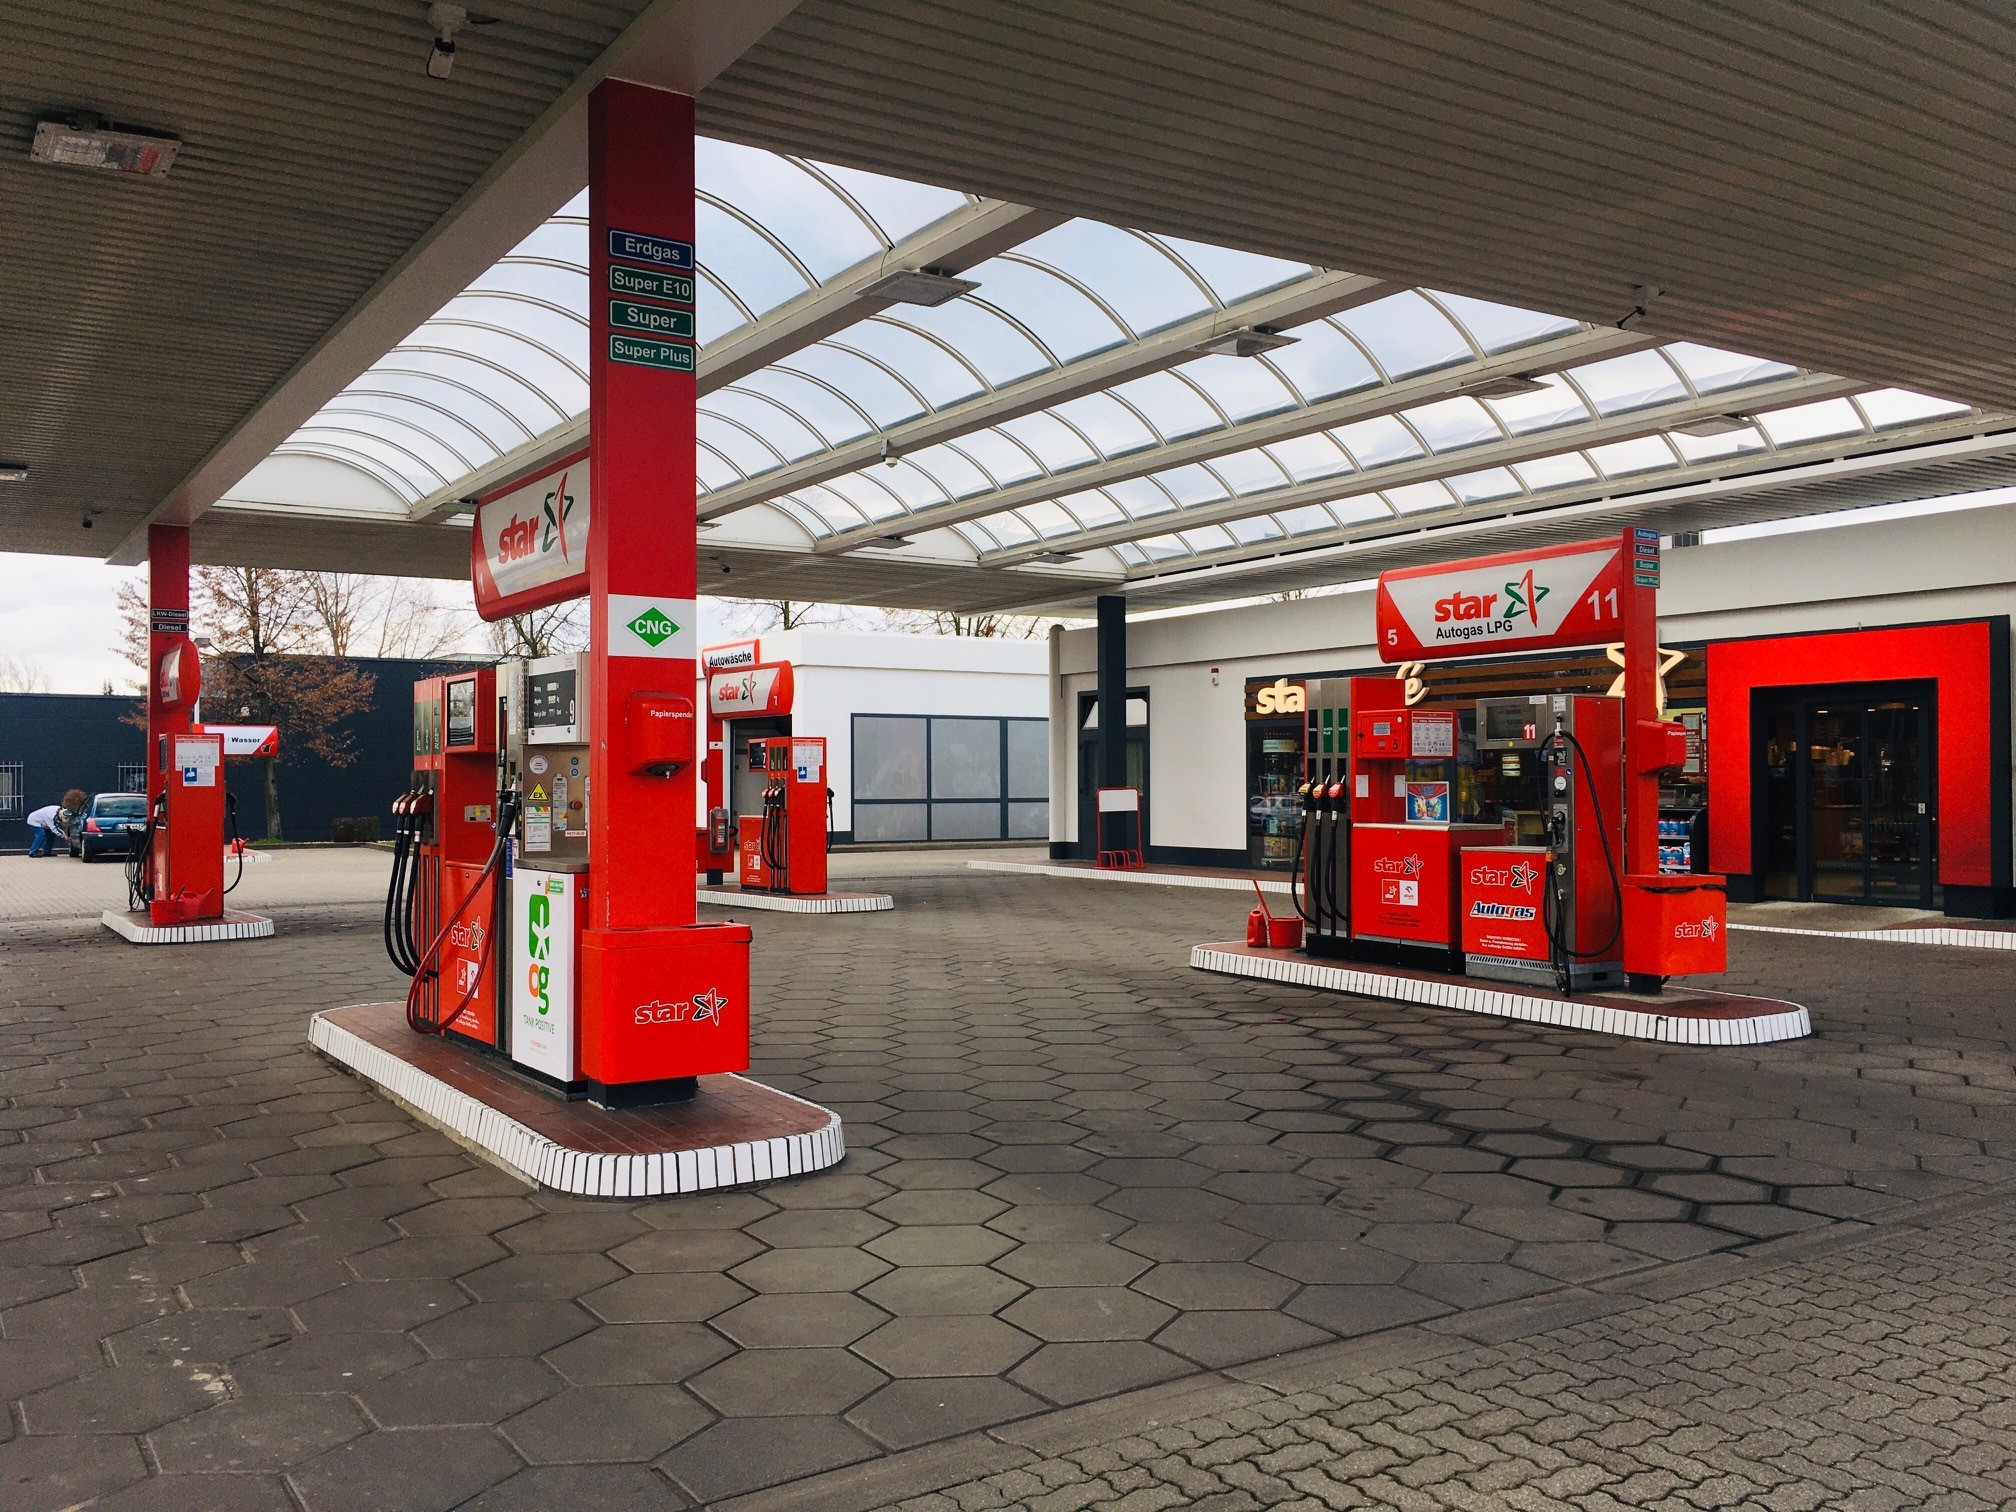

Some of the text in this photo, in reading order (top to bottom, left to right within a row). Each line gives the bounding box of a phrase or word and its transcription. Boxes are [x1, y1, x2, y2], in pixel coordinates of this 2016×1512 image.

[625, 237, 680, 261] Erdgas
[614, 271, 690, 296] Super E10
[627, 307, 677, 329] Super
[614, 341, 690, 364] Super Plus
[498, 513, 539, 564] star
[1639, 545, 1655, 554] Diesel
[1639, 560, 1655, 570] Super
[1434, 588, 1619, 623] star 11
[158, 623, 182, 631] Diesel
[634, 619, 673, 635] CNG
[1387, 620, 1513, 646] 5 Autogas LPG
[709, 651, 752, 667] Autowäsche
[719, 683, 740, 701] star
[1256, 678, 1306, 714] sta
[569, 699, 575, 724] 9
[1523, 724, 1536, 739] 11
[1393, 739, 1399, 750] 5
[1373, 857, 1404, 874] star
[1470, 865, 1509, 886] star
[1471, 901, 1536, 919] Autogas
[451, 921, 471, 948] star
[1674, 921, 1701, 938] star
[634, 1000, 690, 1025] star
